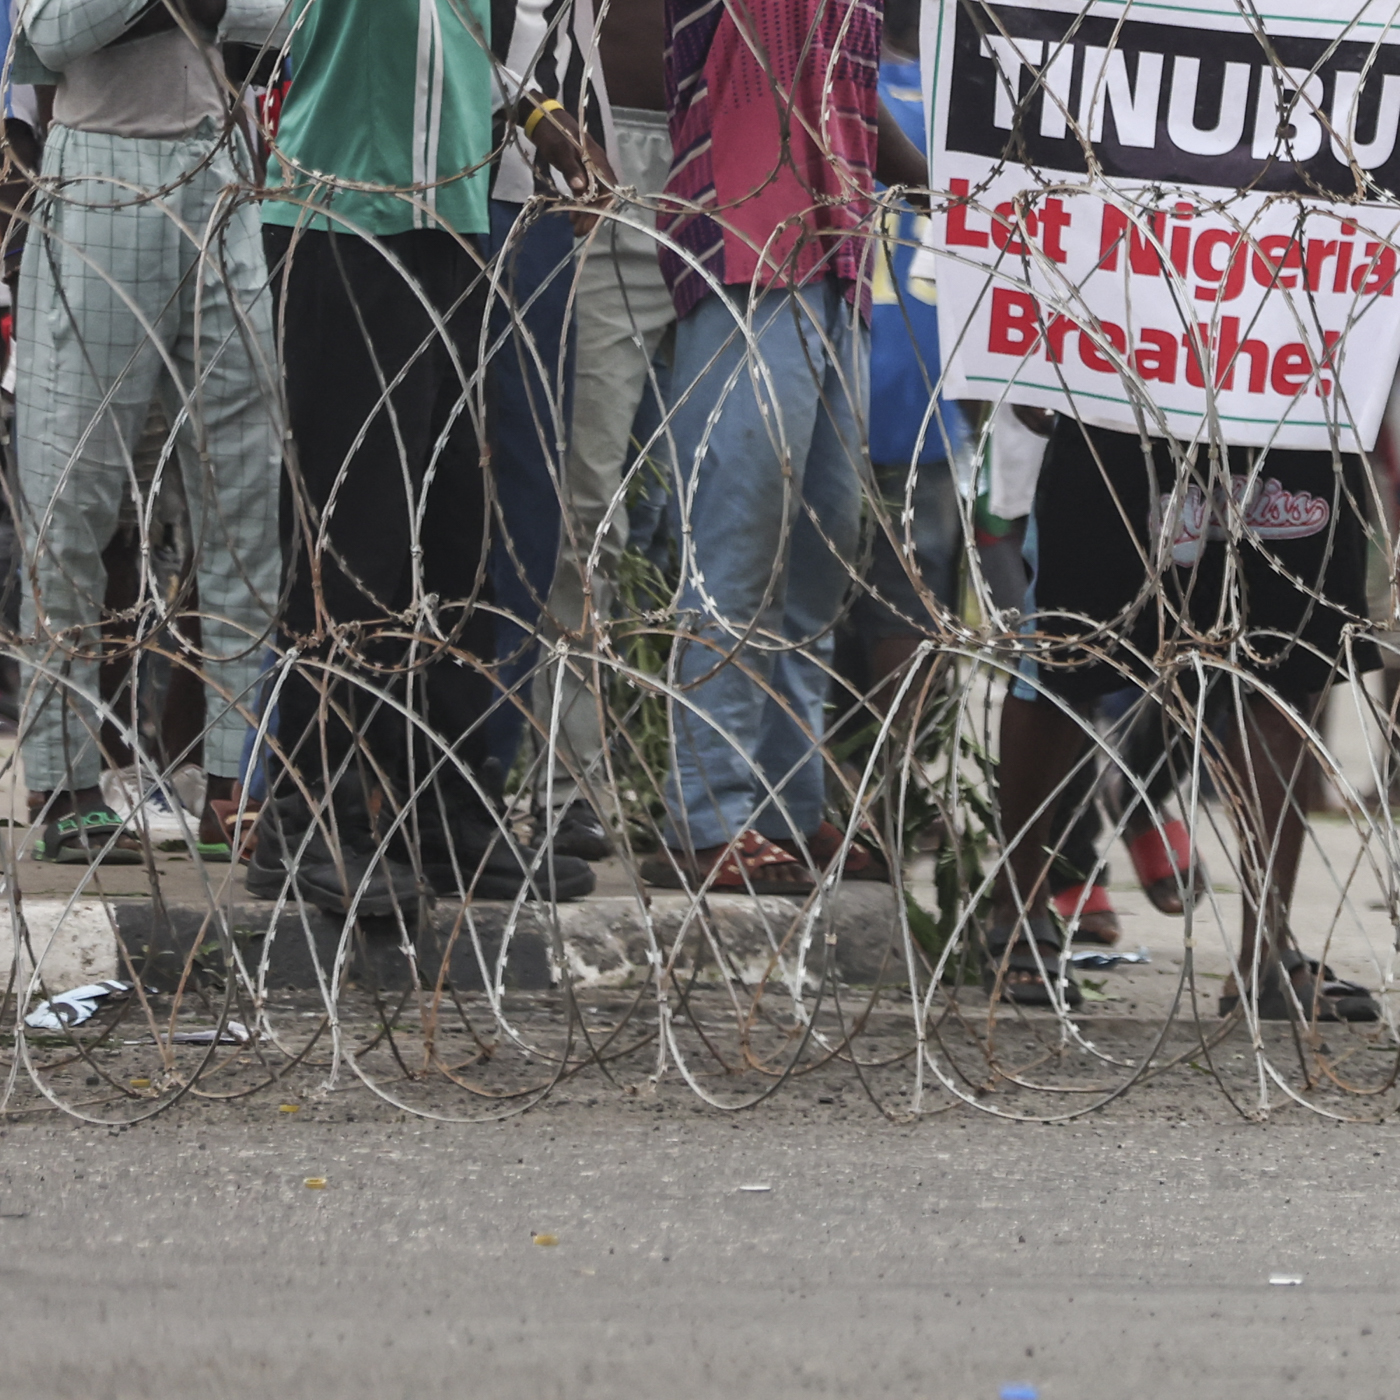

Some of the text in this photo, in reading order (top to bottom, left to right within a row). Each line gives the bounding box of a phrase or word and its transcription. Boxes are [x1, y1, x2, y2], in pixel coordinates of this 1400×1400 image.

[945, 178, 1398, 303] Let Nigeria
[988, 287, 1341, 398] Breathe!
